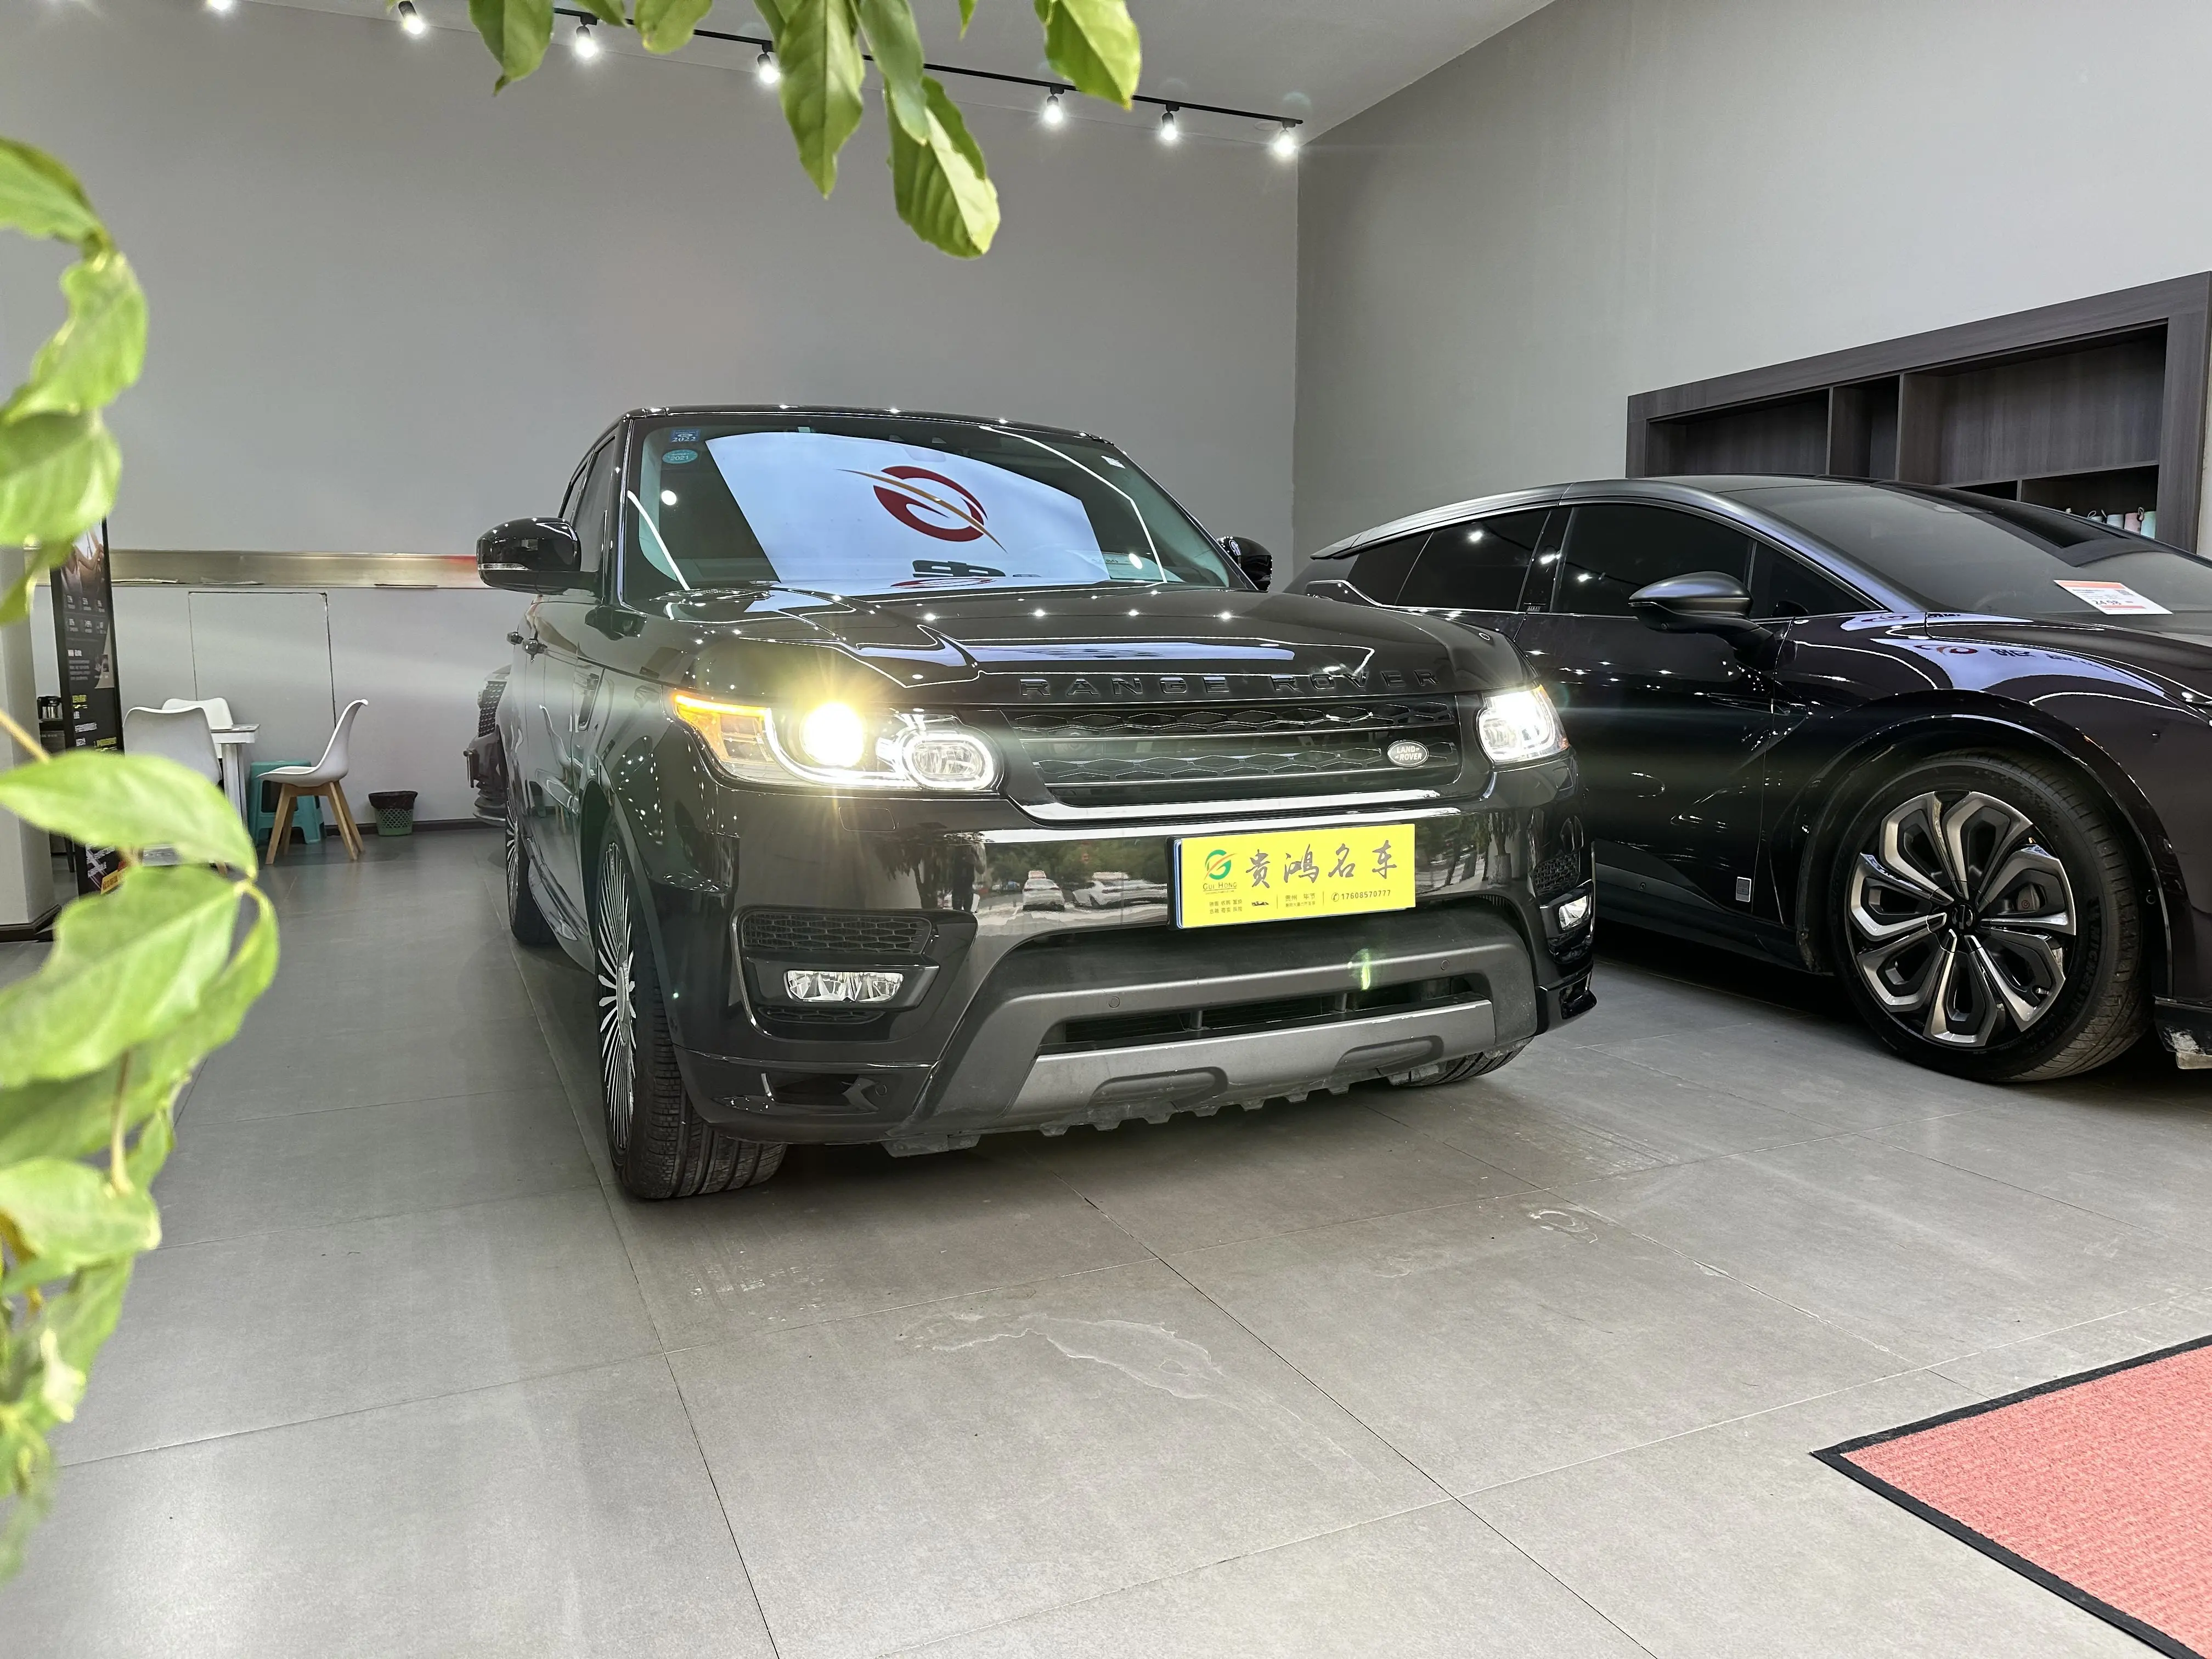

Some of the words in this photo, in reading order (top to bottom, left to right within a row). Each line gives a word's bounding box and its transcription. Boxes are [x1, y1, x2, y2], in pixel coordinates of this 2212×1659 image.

[1019, 676, 1230, 696] RANGE
[1269, 669, 1440, 691] ROVER
[1396, 746, 1415, 754] LAND
[1399, 753, 1422, 761] ROVER
[1245, 840, 1397, 889] 贵鸿名车
[1341, 889, 1391, 900] 17608570777
